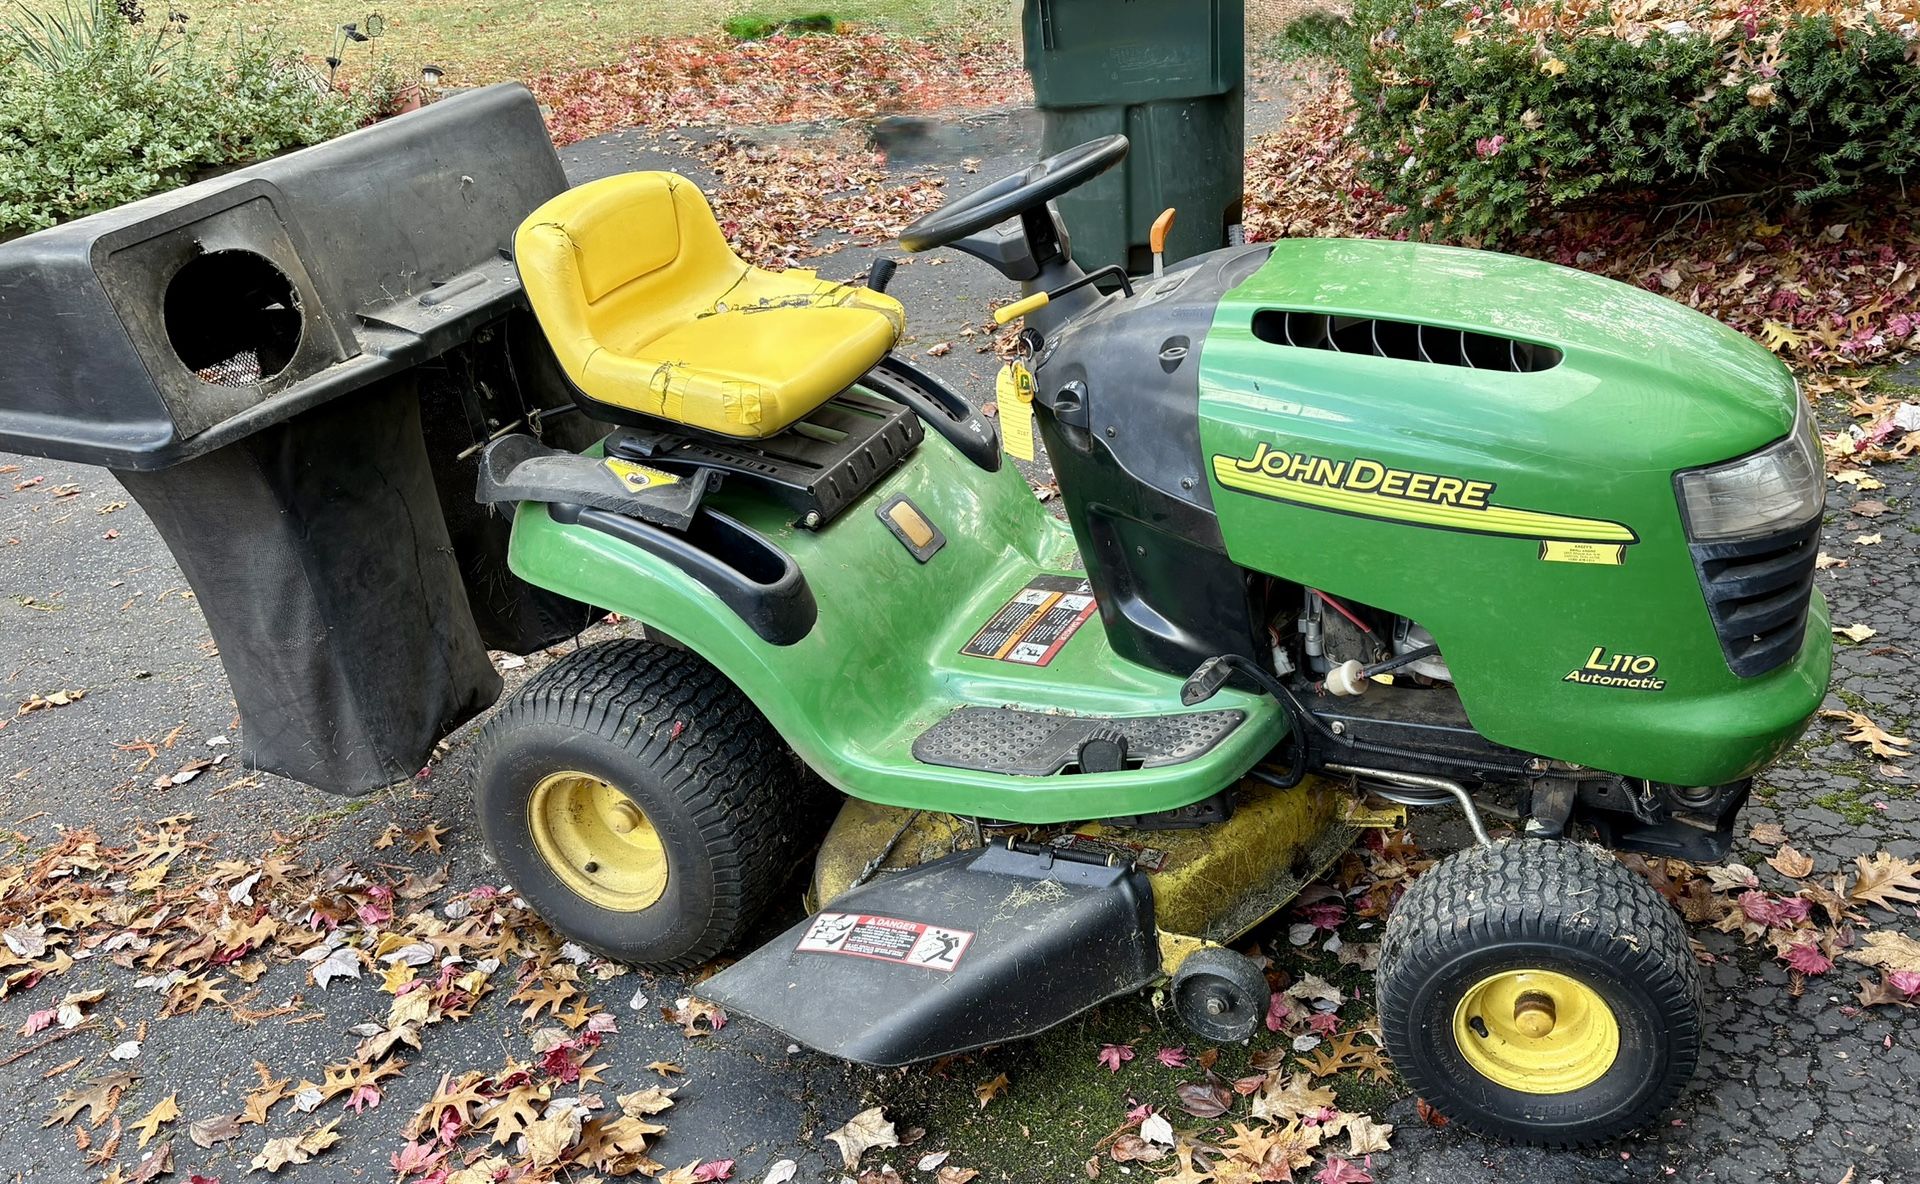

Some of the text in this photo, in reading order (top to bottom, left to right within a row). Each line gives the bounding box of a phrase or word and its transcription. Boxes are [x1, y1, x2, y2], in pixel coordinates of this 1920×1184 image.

[1236, 442, 1495, 510] JOHN DEERE
[1584, 647, 1657, 675] L110
[1563, 670, 1665, 690] Automatic
[877, 918, 917, 931] DANGER
